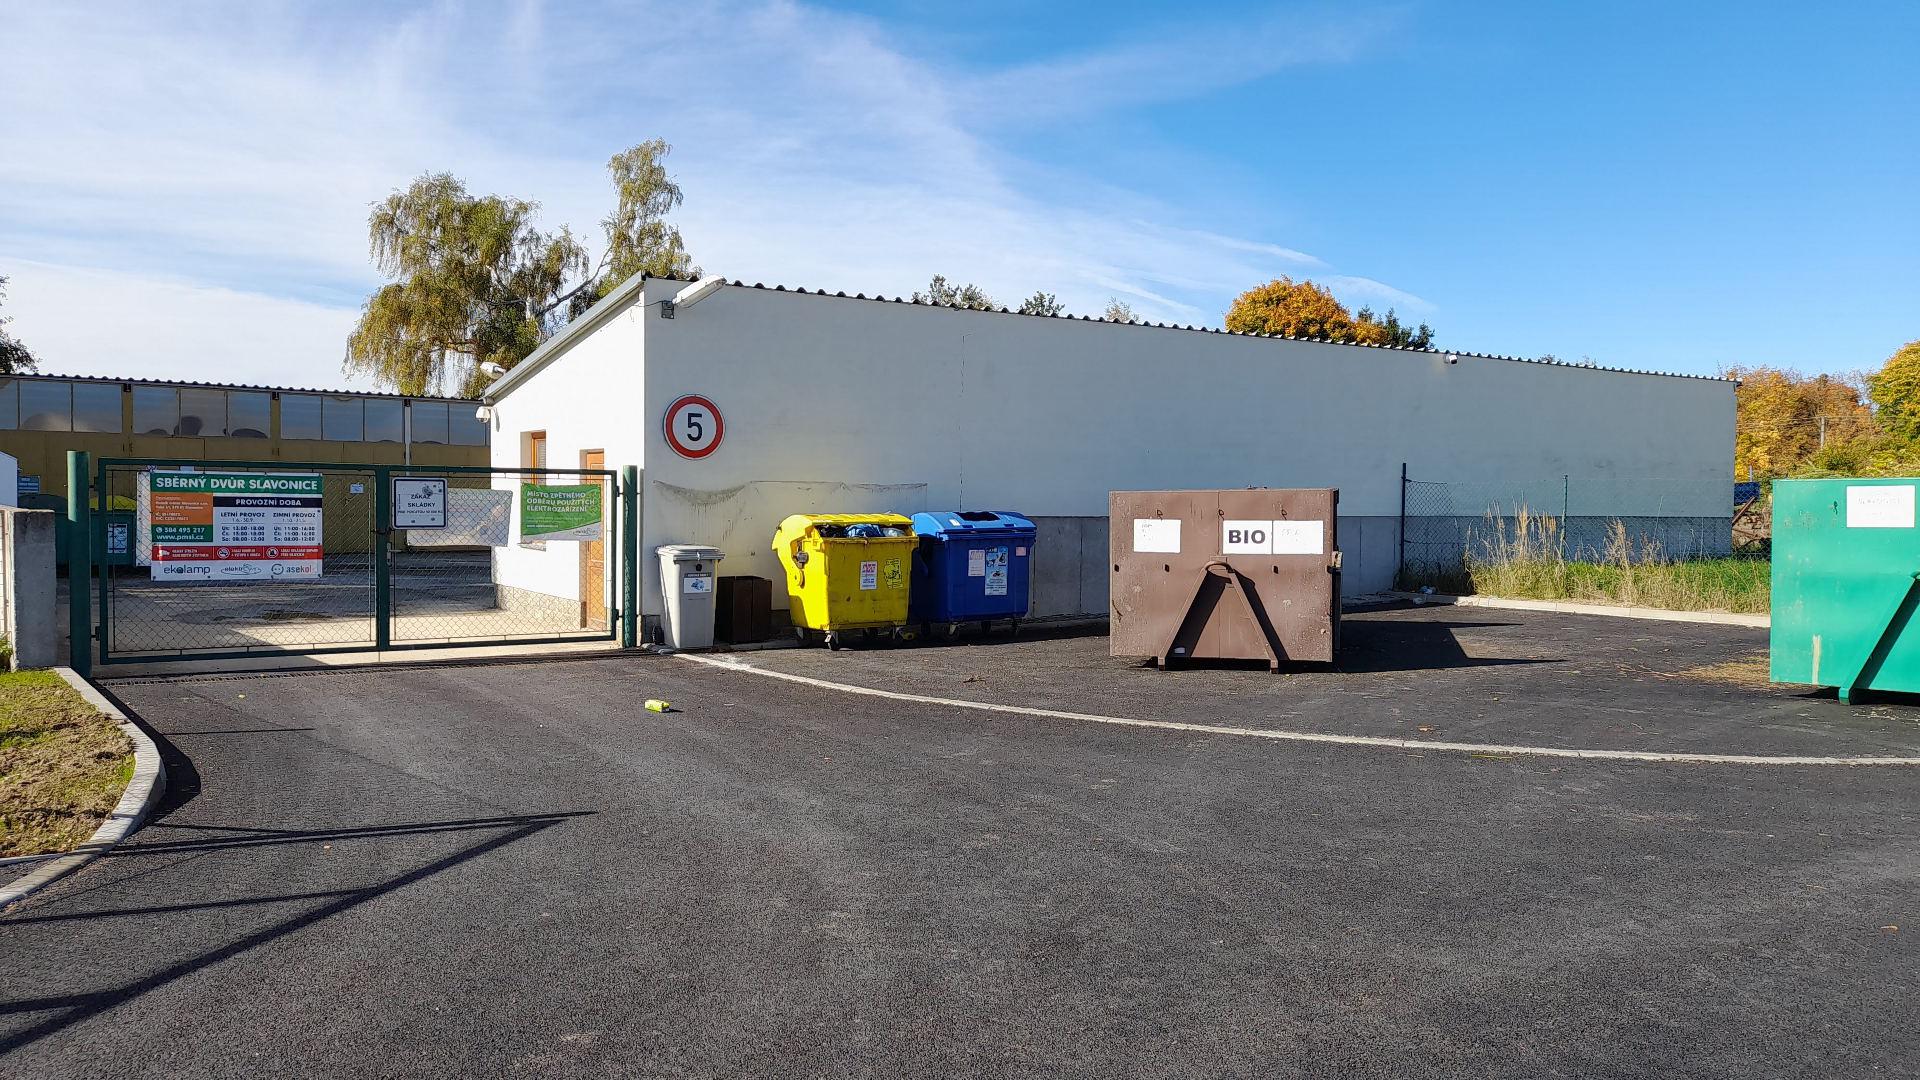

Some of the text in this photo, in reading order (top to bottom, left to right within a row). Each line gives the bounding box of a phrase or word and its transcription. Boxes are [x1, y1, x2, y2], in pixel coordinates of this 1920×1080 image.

[687, 412, 703, 442] 5
[156, 475, 318, 490] SBĚRNÝ DVŮR SLAVONICE
[526, 490, 549, 498] MÍSTO
[235, 498, 277, 506] PROVOZNÍ
[1228, 529, 1266, 544] BIO
[163, 564, 211, 575] ekolamp
[286, 565, 312, 573] asekol
